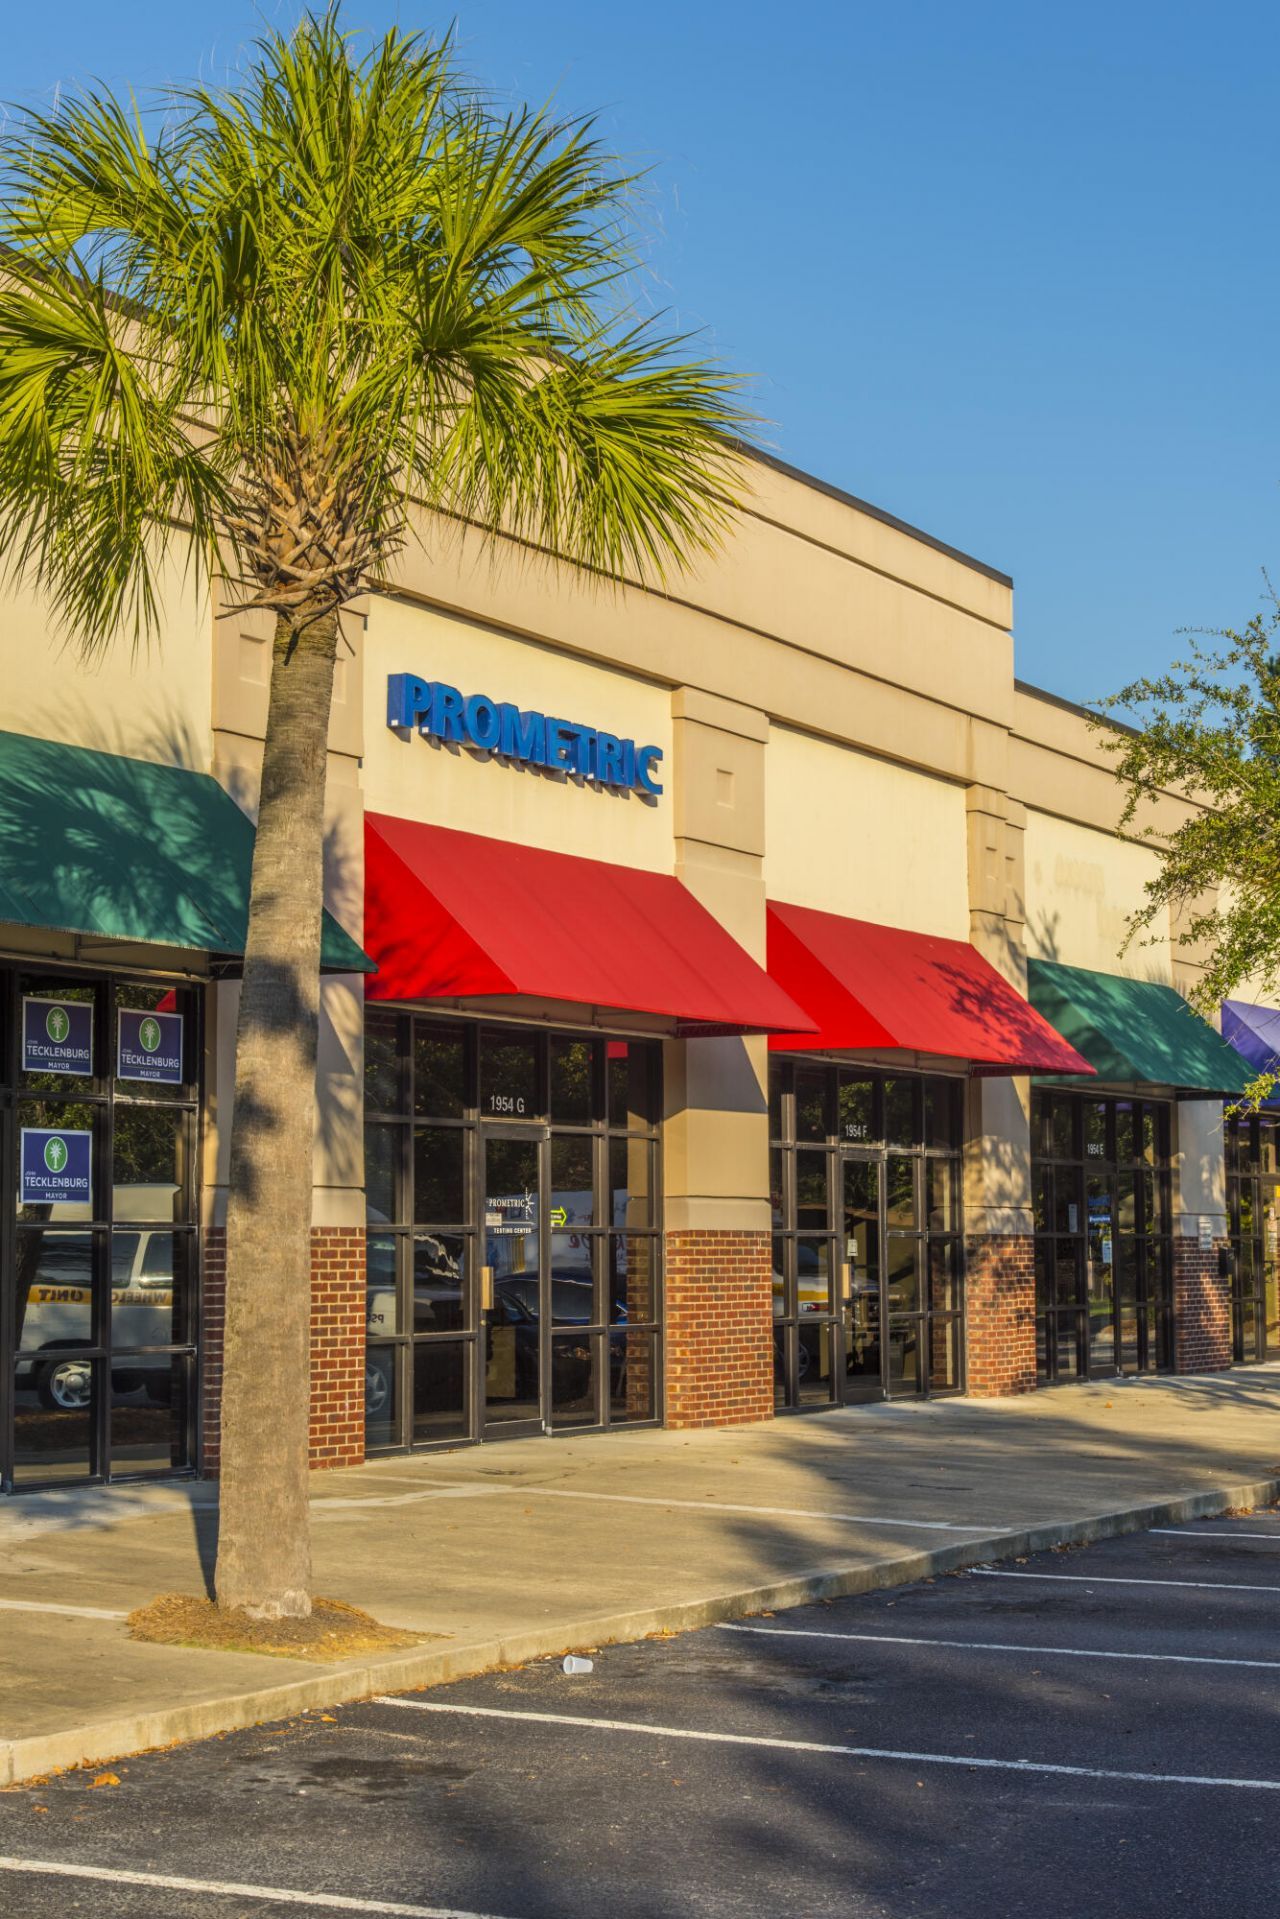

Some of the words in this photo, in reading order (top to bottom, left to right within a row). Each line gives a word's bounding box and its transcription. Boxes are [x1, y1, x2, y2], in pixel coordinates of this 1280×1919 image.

[387, 672, 663, 795] PROMETRIC
[26, 1045, 90, 1059] TECKLENBURG
[48, 1061, 70, 1070] MAYOR
[121, 1053, 180, 1068] TECKLENBURG
[140, 1070, 160, 1078] MAYOR
[490, 1095, 514, 1112] 1954
[516, 1097, 525, 1113] G
[845, 1124, 861, 1137] 1954
[862, 1125, 868, 1137] F
[25, 1176, 88, 1188] TECKLENBURG
[45, 1191, 68, 1200] MAYOR
[488, 1198, 525, 1208] PROMETRIC
